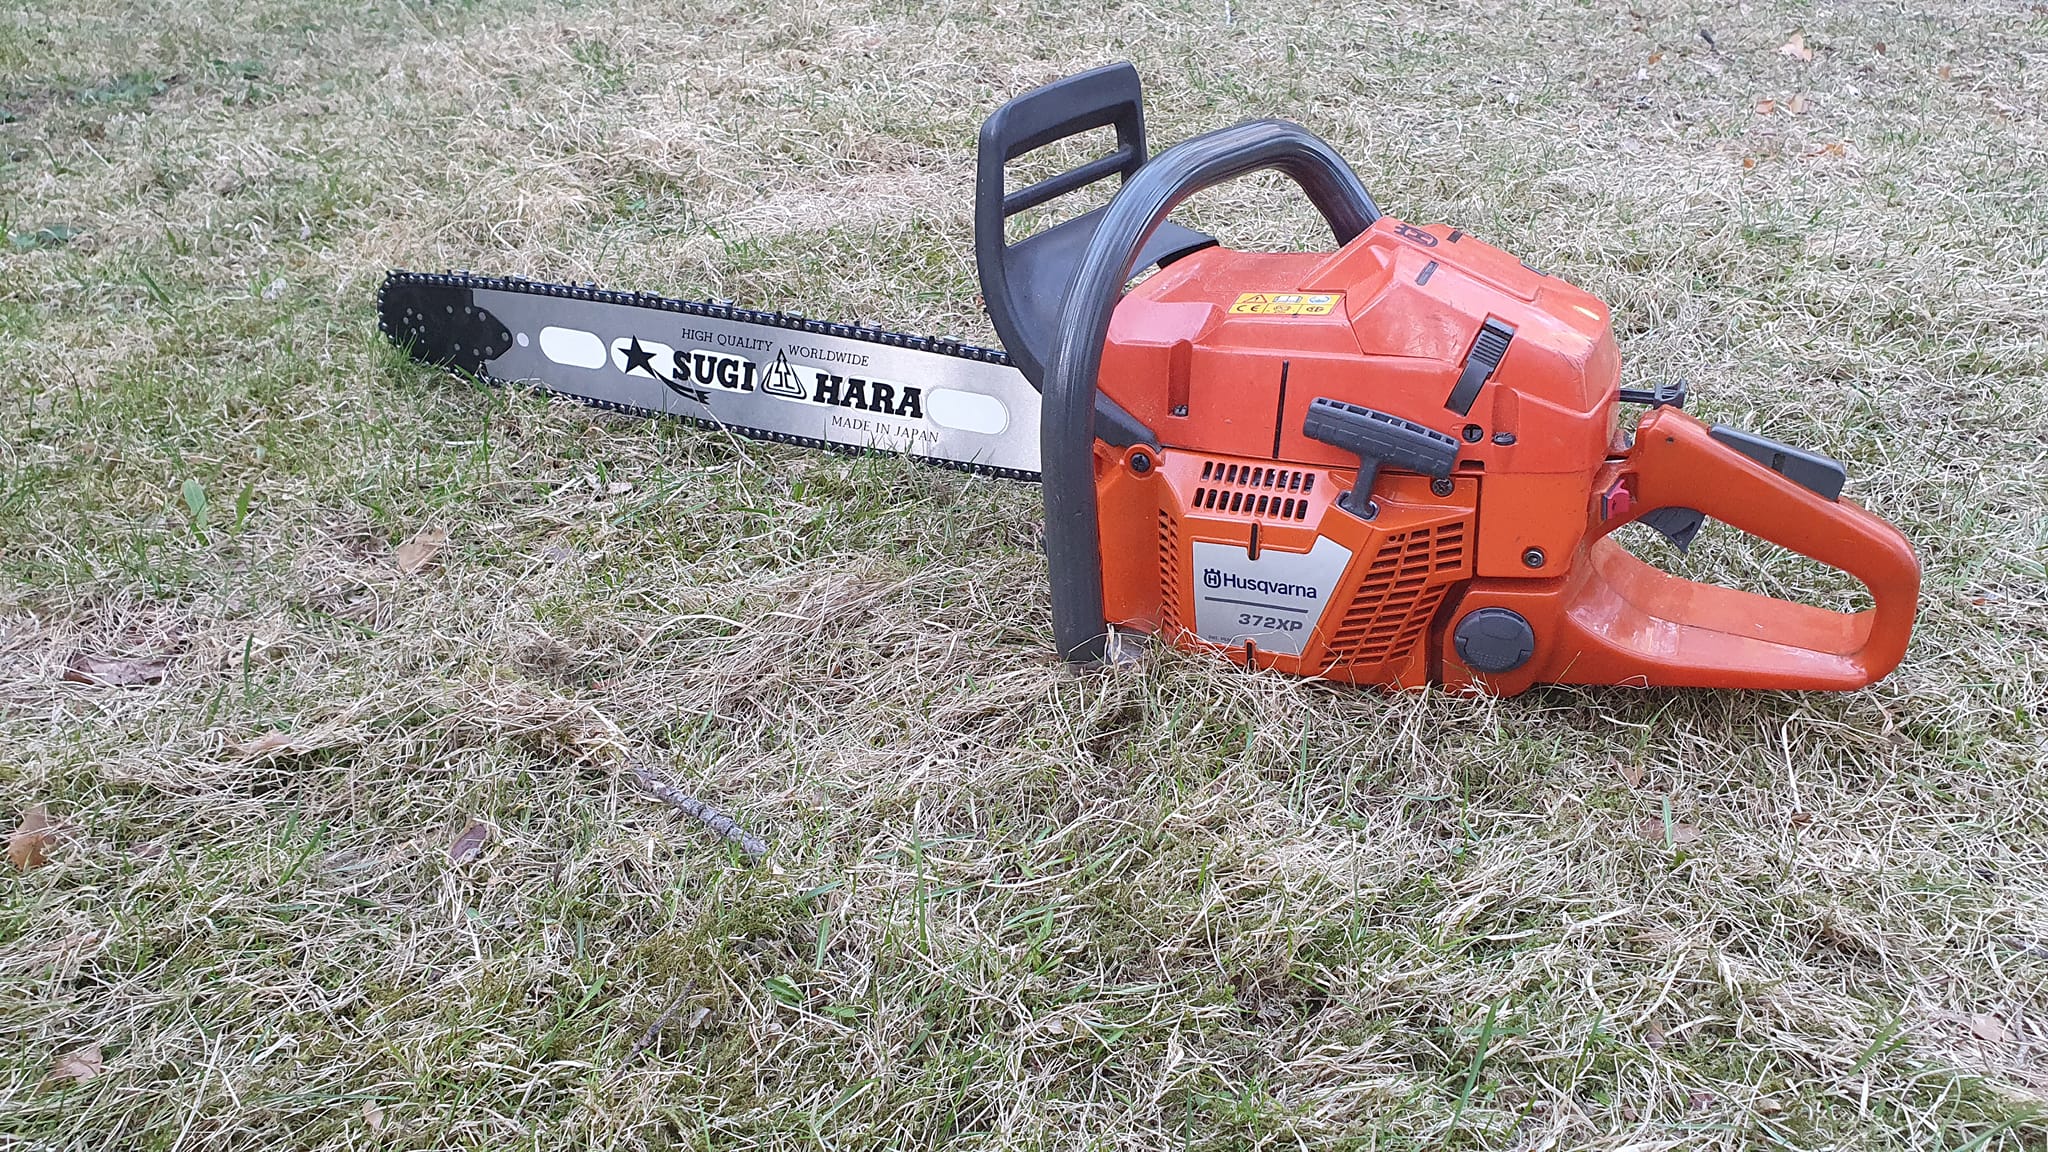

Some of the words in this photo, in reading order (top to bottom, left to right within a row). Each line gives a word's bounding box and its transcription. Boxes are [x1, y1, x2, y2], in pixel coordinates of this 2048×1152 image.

[681, 327, 713, 343] HIGH
[716, 333, 774, 352] QUALITY
[788, 344, 870, 367] WORLDWIDE
[672, 350, 757, 392] SUGI
[813, 373, 924, 418] HARA
[831, 415, 872, 432] MADE
[875, 422, 891, 436] IN
[894, 425, 939, 443] JAPAN
[1223, 572, 1317, 599] Husqvarna
[1238, 613, 1303, 632] 372XP
